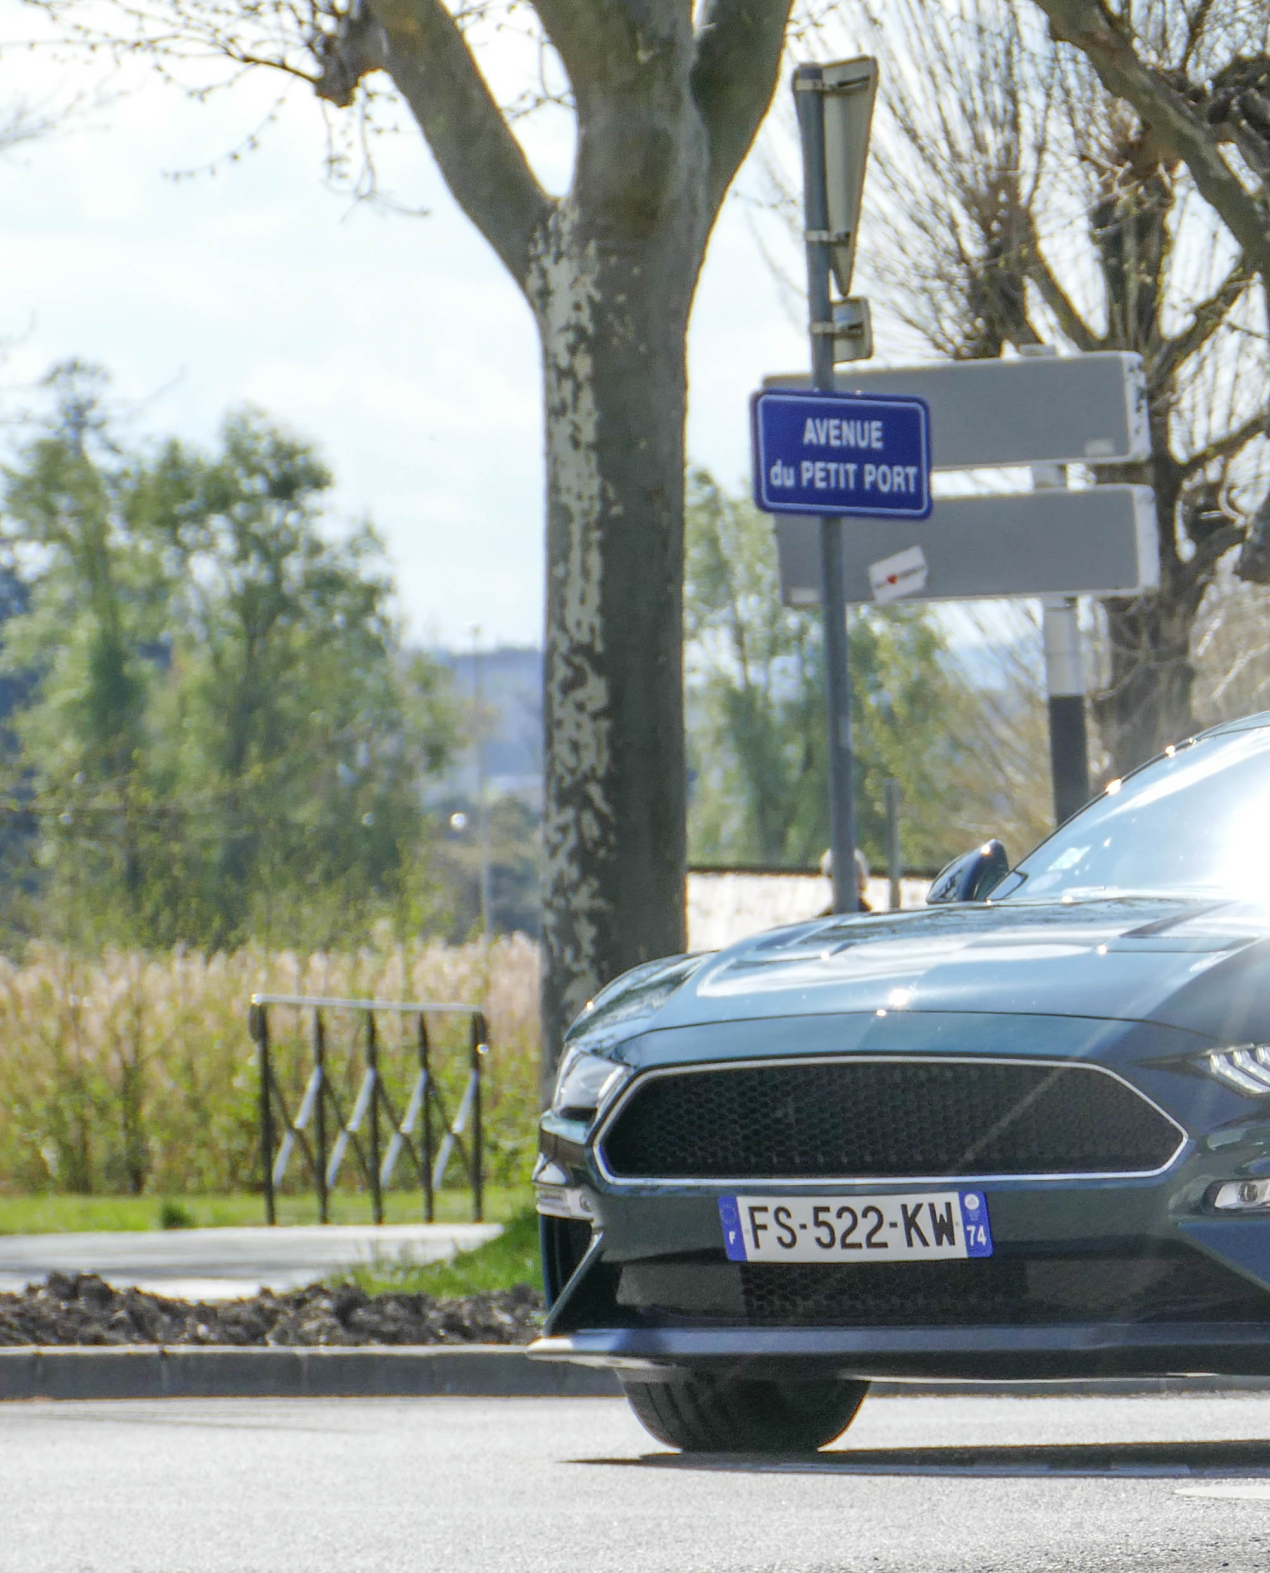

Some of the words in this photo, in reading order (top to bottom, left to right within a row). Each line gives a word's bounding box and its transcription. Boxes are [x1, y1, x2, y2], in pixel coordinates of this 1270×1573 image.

[802, 417, 884, 450] AVENUE
[769, 459, 796, 488] du
[800, 460, 859, 490] PETIT
[863, 463, 918, 494] PORT
[728, 1230, 736, 1245] F
[748, 1202, 956, 1249] FS-522-KW
[966, 1225, 987, 1247] 74
